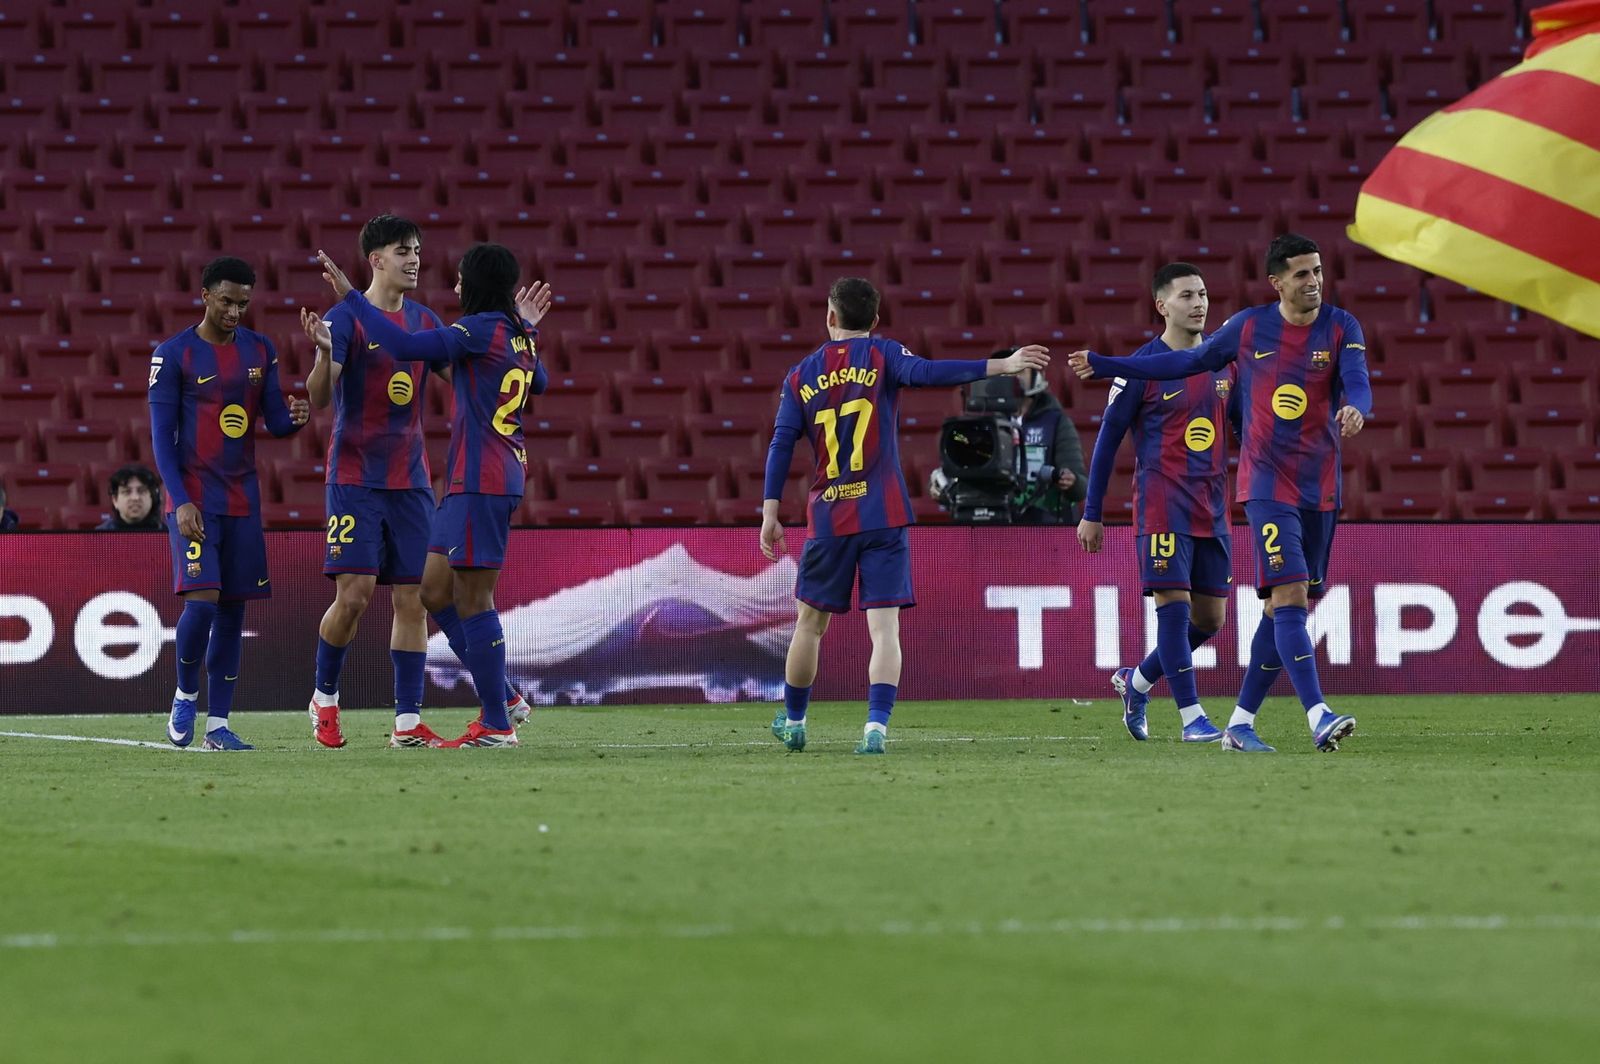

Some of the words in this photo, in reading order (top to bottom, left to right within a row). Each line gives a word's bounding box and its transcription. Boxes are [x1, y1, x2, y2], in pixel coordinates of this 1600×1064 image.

[799, 383, 819, 404] M.
[816, 366, 878, 388] CASADÓ
[814, 397, 873, 479] 17
[838, 481, 868, 492] UNHCR
[838, 487, 868, 498] ACNUR
[326, 514, 356, 544] 22
[1262, 522, 1282, 554] 2
[1150, 533, 1176, 558] 19
